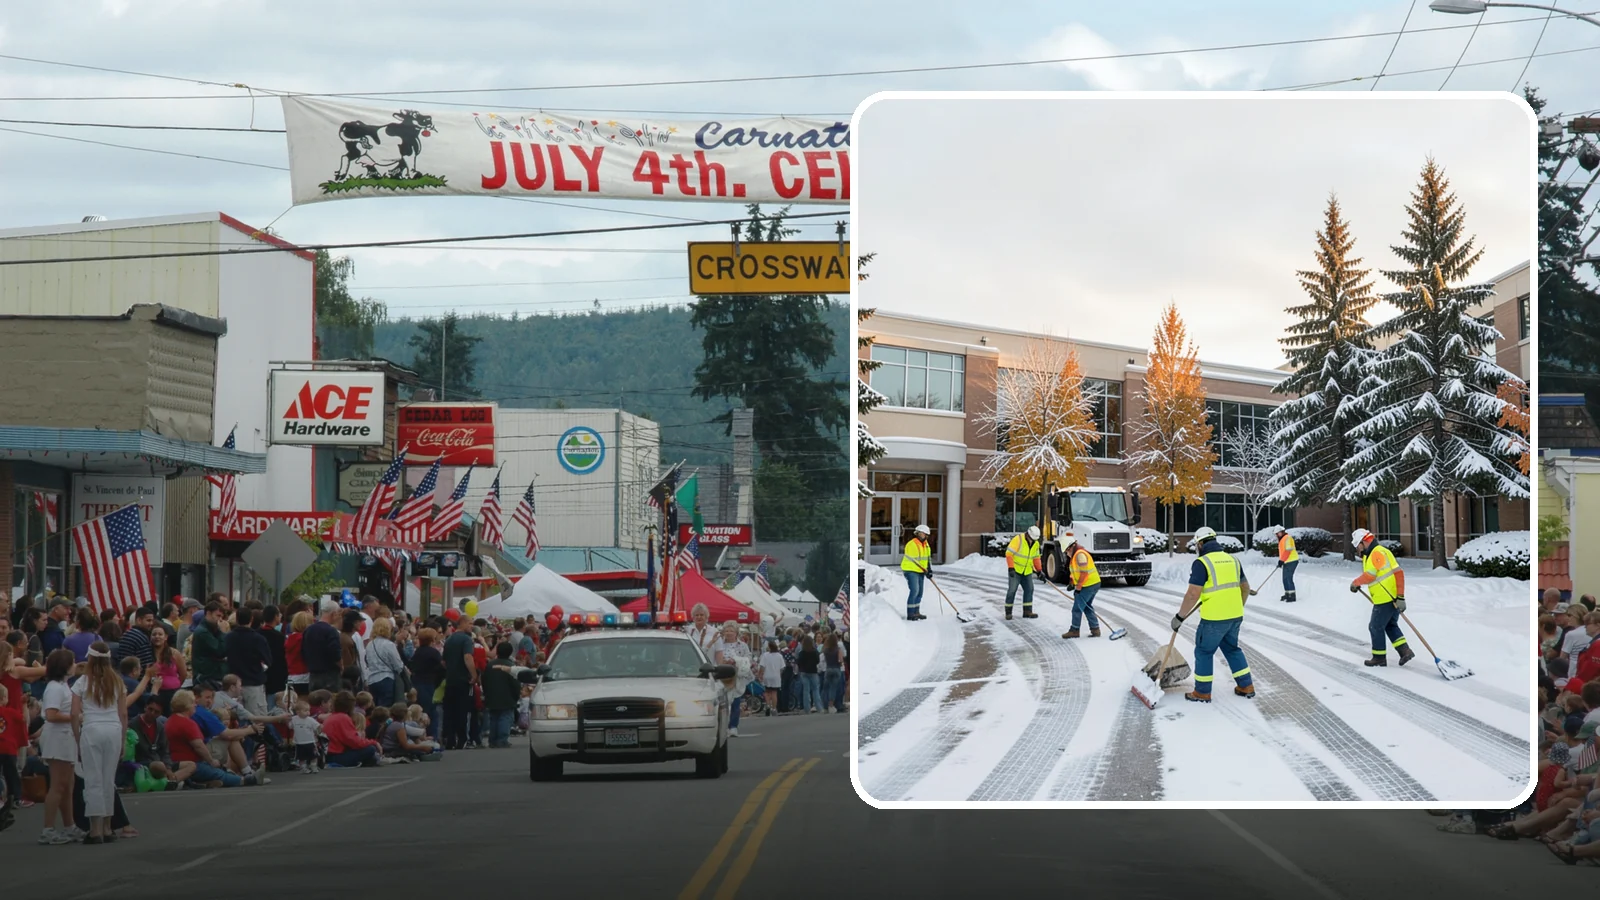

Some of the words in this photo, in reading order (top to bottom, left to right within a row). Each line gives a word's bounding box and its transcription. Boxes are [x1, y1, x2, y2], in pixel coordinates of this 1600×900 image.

[694, 121, 850, 150] Carnat
[480, 140, 606, 192] JULY
[632, 149, 747, 199] 4th.
[697, 253, 850, 281] CROSSWA
[282, 379, 373, 420] ACE
[405, 408, 453, 422] CEDAR
[460, 408, 486, 422] LOG
[283, 420, 371, 437] Hardware
[417, 428, 476, 447] Coca-Cola
[95, 485, 125, 495] Vincent
[126, 486, 136, 495] de
[137, 486, 156, 496] Paul
[688, 526, 741, 536] CRNATION
[699, 535, 731, 544] GLASS
